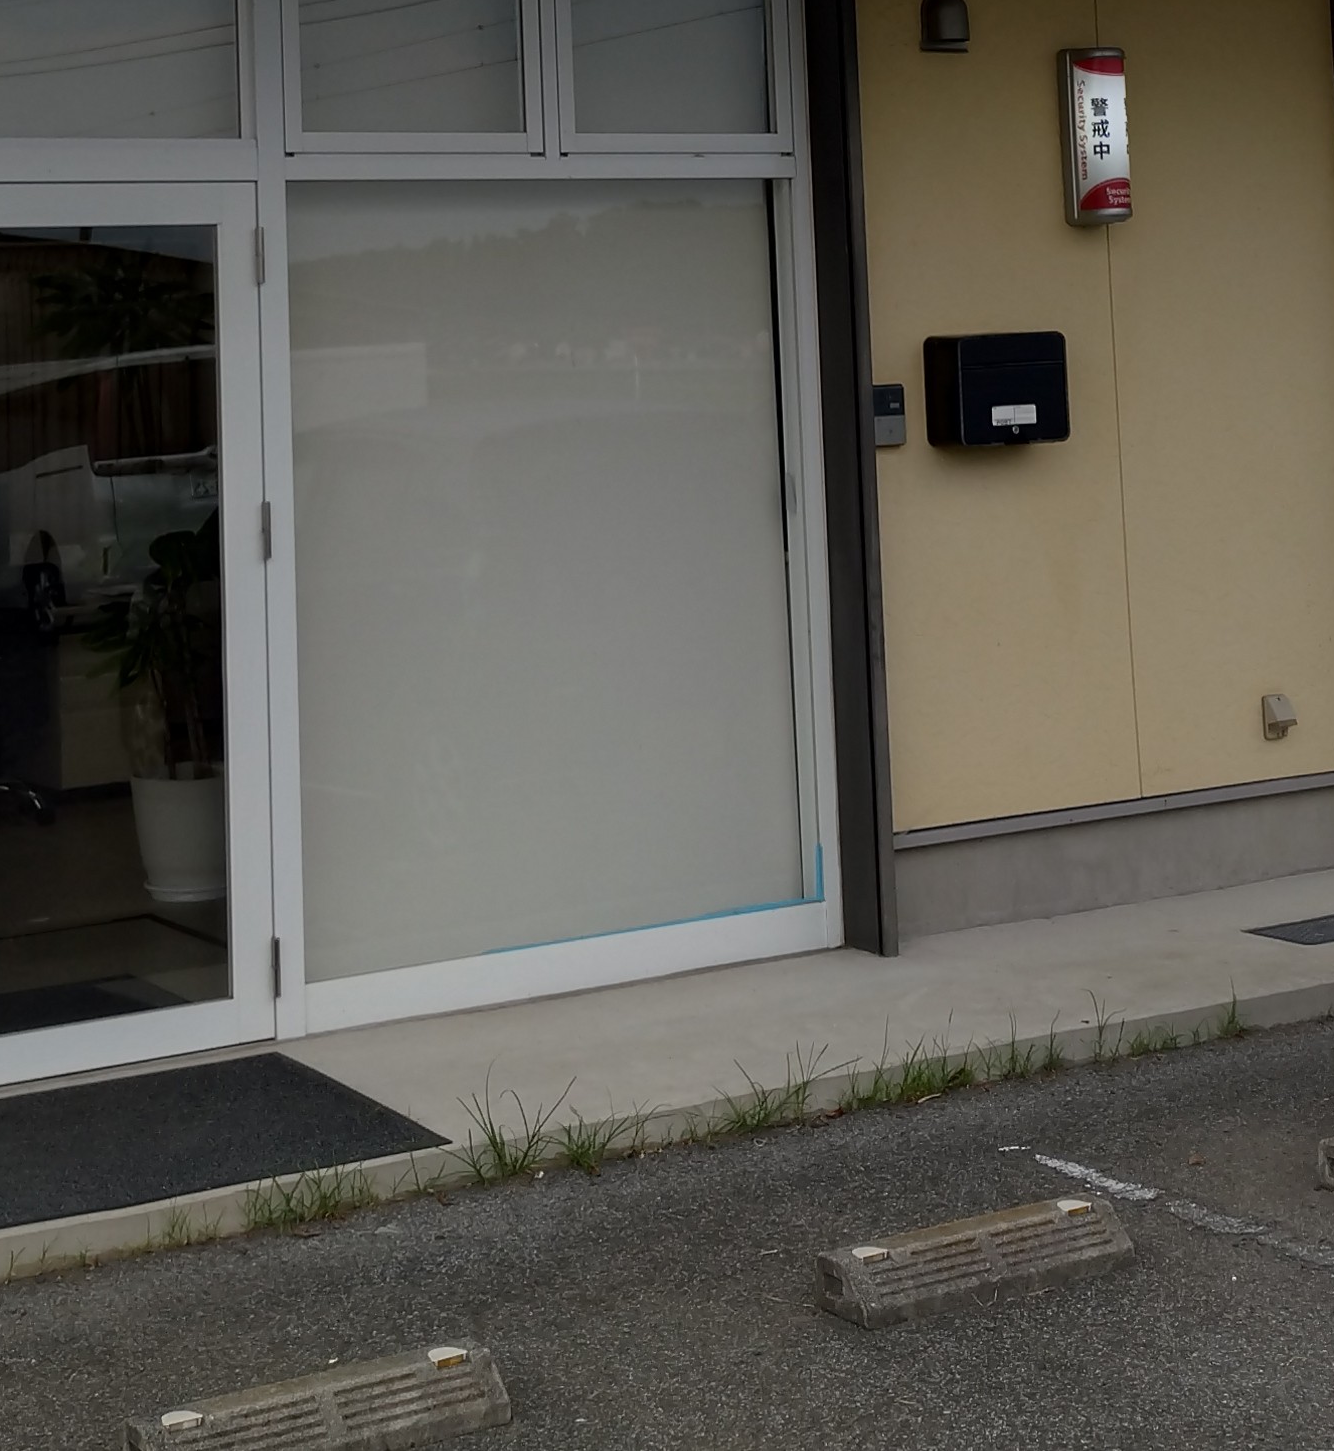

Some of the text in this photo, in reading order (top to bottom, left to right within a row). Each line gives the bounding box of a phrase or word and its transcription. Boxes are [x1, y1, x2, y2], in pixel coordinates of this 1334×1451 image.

[1076, 79, 1089, 181] Security System
[1090, 97, 1111, 160] 警戒中
